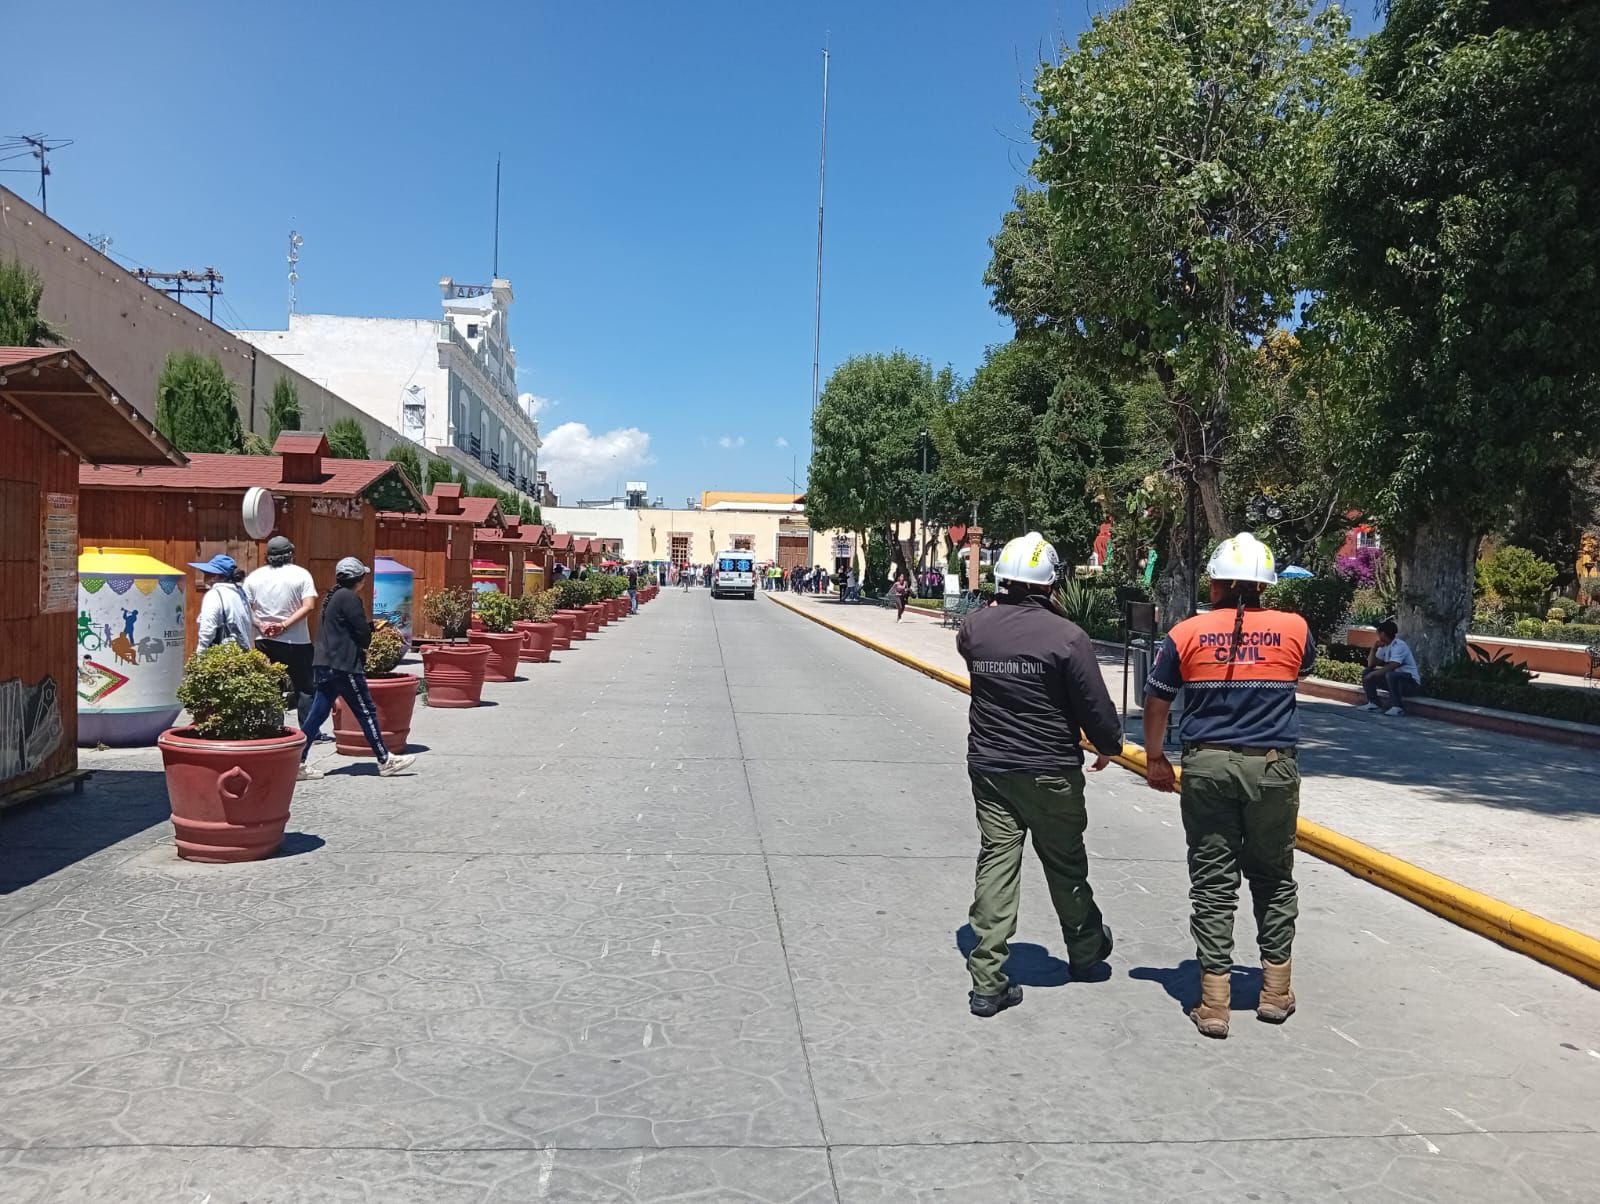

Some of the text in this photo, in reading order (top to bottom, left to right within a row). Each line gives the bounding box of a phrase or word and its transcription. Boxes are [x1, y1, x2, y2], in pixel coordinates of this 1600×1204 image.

[1199, 628, 1281, 648] PROTCCIÓN
[972, 659, 1046, 674] PROTECCIÓN CIVIL
